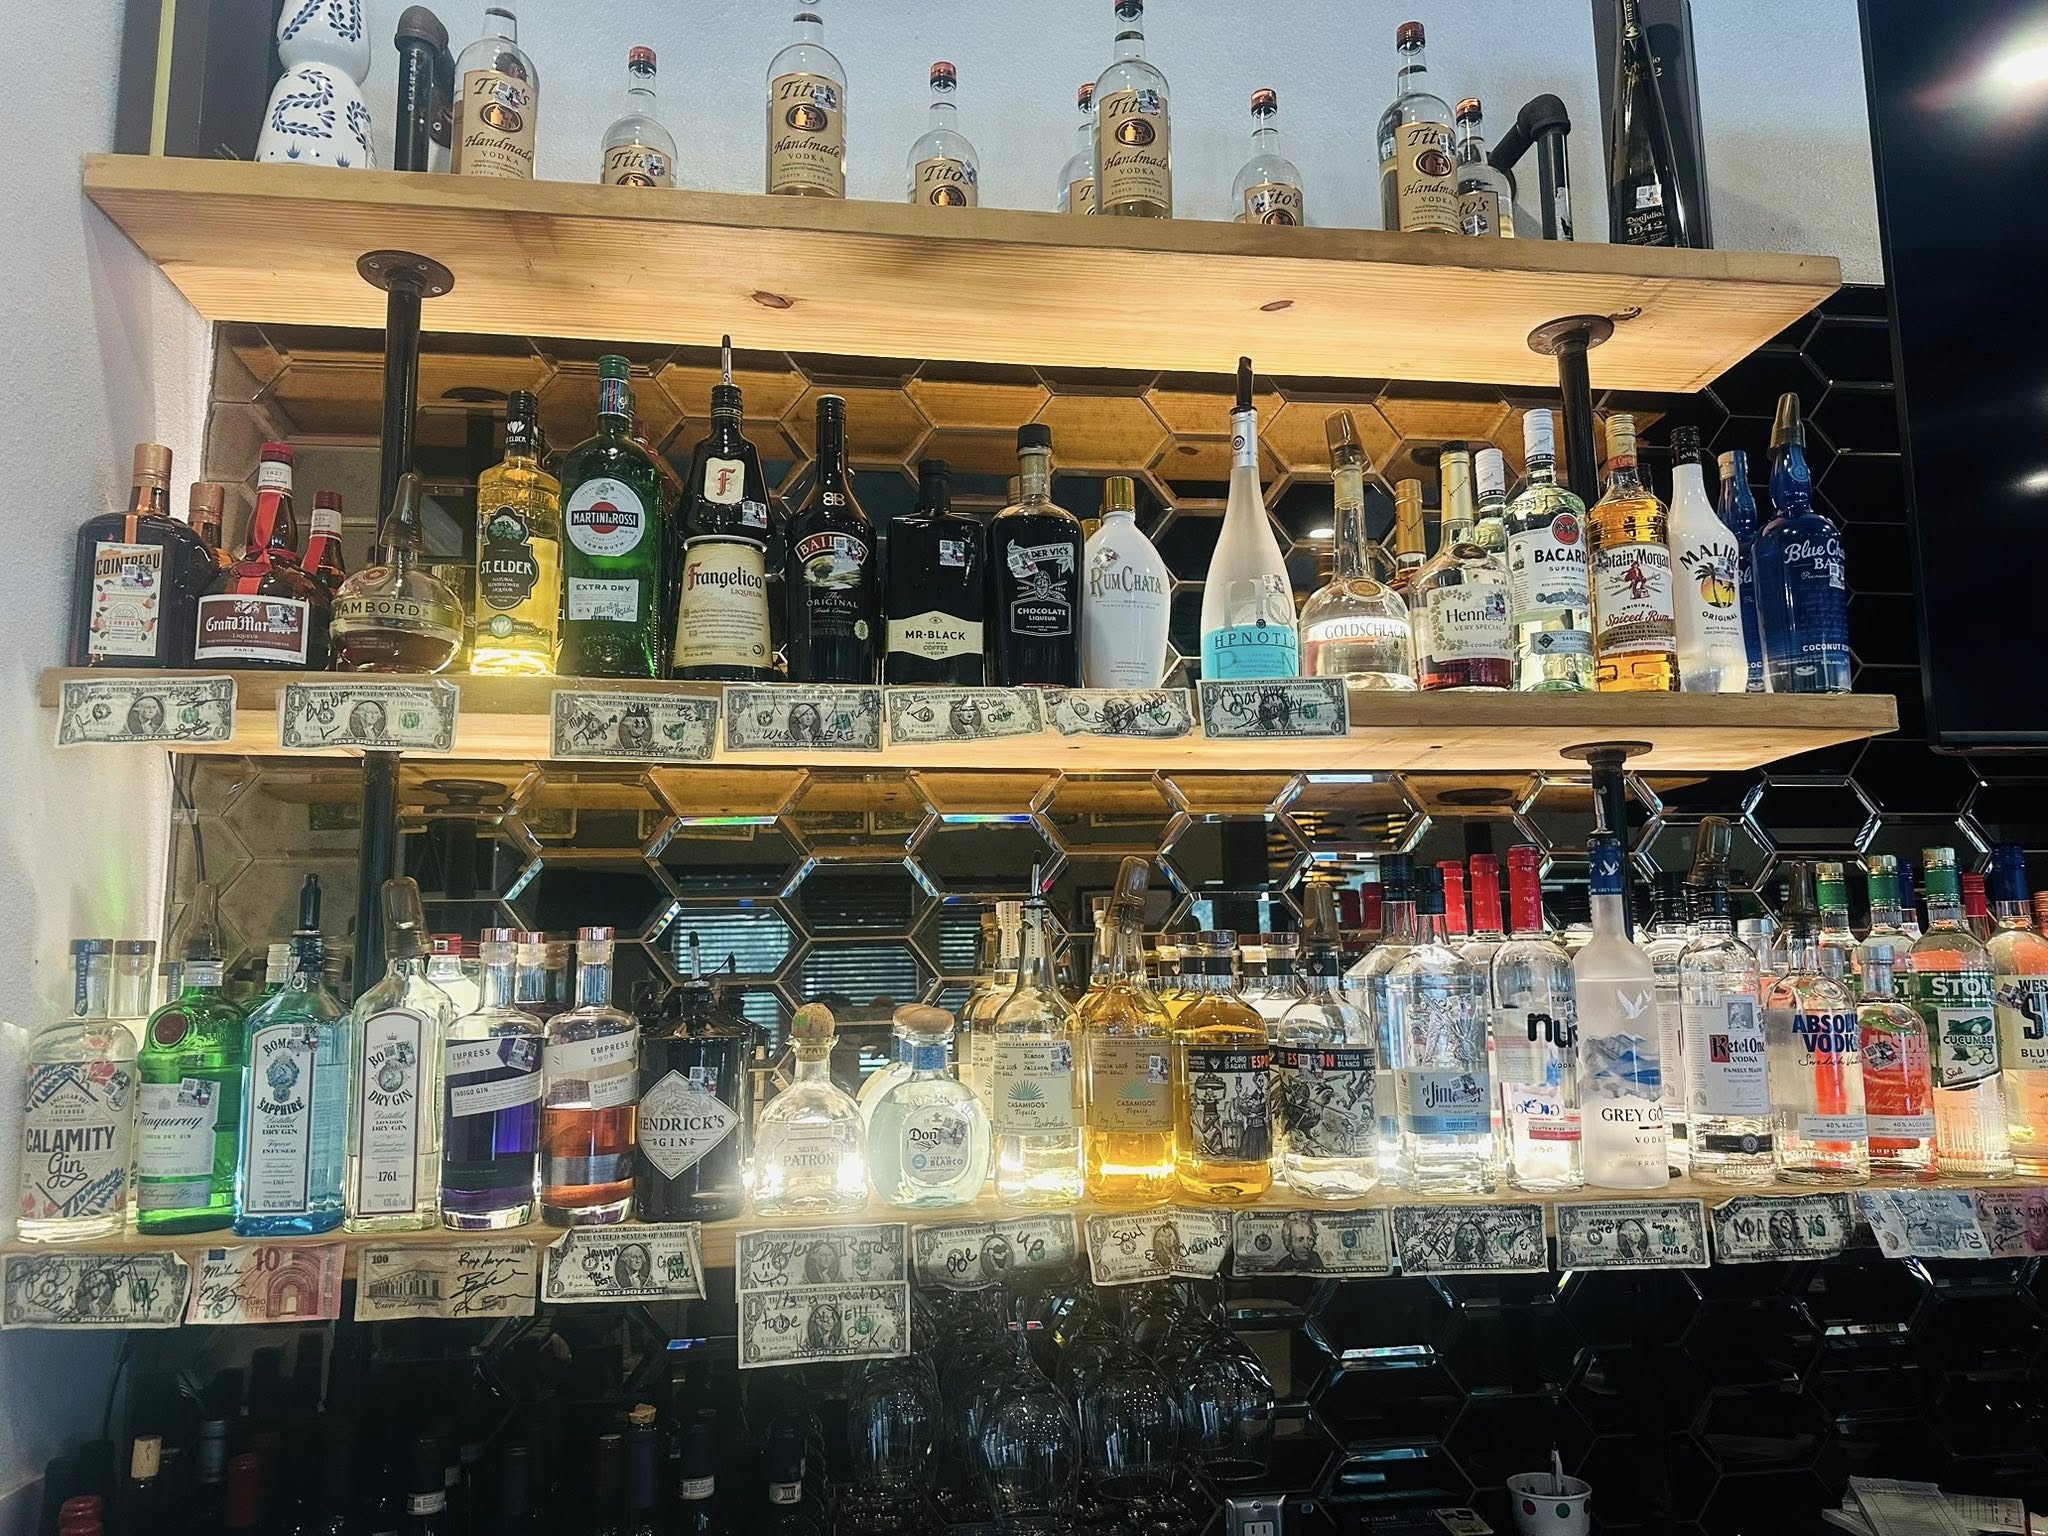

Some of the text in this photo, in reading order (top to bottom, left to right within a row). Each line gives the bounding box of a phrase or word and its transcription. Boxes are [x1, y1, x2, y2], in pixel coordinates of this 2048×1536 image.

[465, 132, 533, 163] Handmade
[774, 136, 840, 158] Handmade
[481, 150, 519, 166] VODKA
[788, 153, 825, 164] VODKA
[1104, 151, 1167, 170] Handmade
[1627, 222, 1664, 235] 1942
[584, 541, 624, 550] VERMOUTH
[1535, 549, 1587, 564] BACARD
[1636, 549, 1670, 568] Morgan
[1784, 543, 1825, 565] Blue
[494, 560, 532, 575] ELDER
[688, 562, 762, 591] Frangelico
[731, 588, 762, 598] LIQUEUR
[335, 602, 420, 616] HAMBORD
[806, 599, 858, 608] ORIGINAL
[1017, 608, 1066, 616] CHOCOLATE
[1605, 610, 1643, 627] Spiced
[1702, 611, 1738, 622] ORIGINAL
[1803, 644, 1840, 652] COCONUT
[1712, 1035, 1750, 1055] Ketel
[1943, 1035, 1995, 1044] CUCUMBER
[452, 1049, 491, 1060] EMPRESS
[590, 1041, 629, 1055] EMPRESS
[368, 1088, 413, 1107] DRY GIN
[454, 1087, 489, 1097] INDIGO GIN
[257, 1097, 306, 1116] SAPPHIRE
[140, 1112, 203, 1129] Tanqueray
[639, 1114, 725, 1131] HENDRICK'S
[1601, 1108, 1644, 1122] GREY
[26, 1126, 116, 1153] CALAMITY
[909, 1127, 937, 1142] Don
[659, 1138, 688, 1147] GIN
[47, 1152, 88, 1189] Gin
[378, 1171, 397, 1182] 1761
[1966, 1232, 1982, 1249] 20
[510, 1244, 526, 1253] 100
[253, 1248, 280, 1271] 10
[371, 1254, 389, 1264] 100
